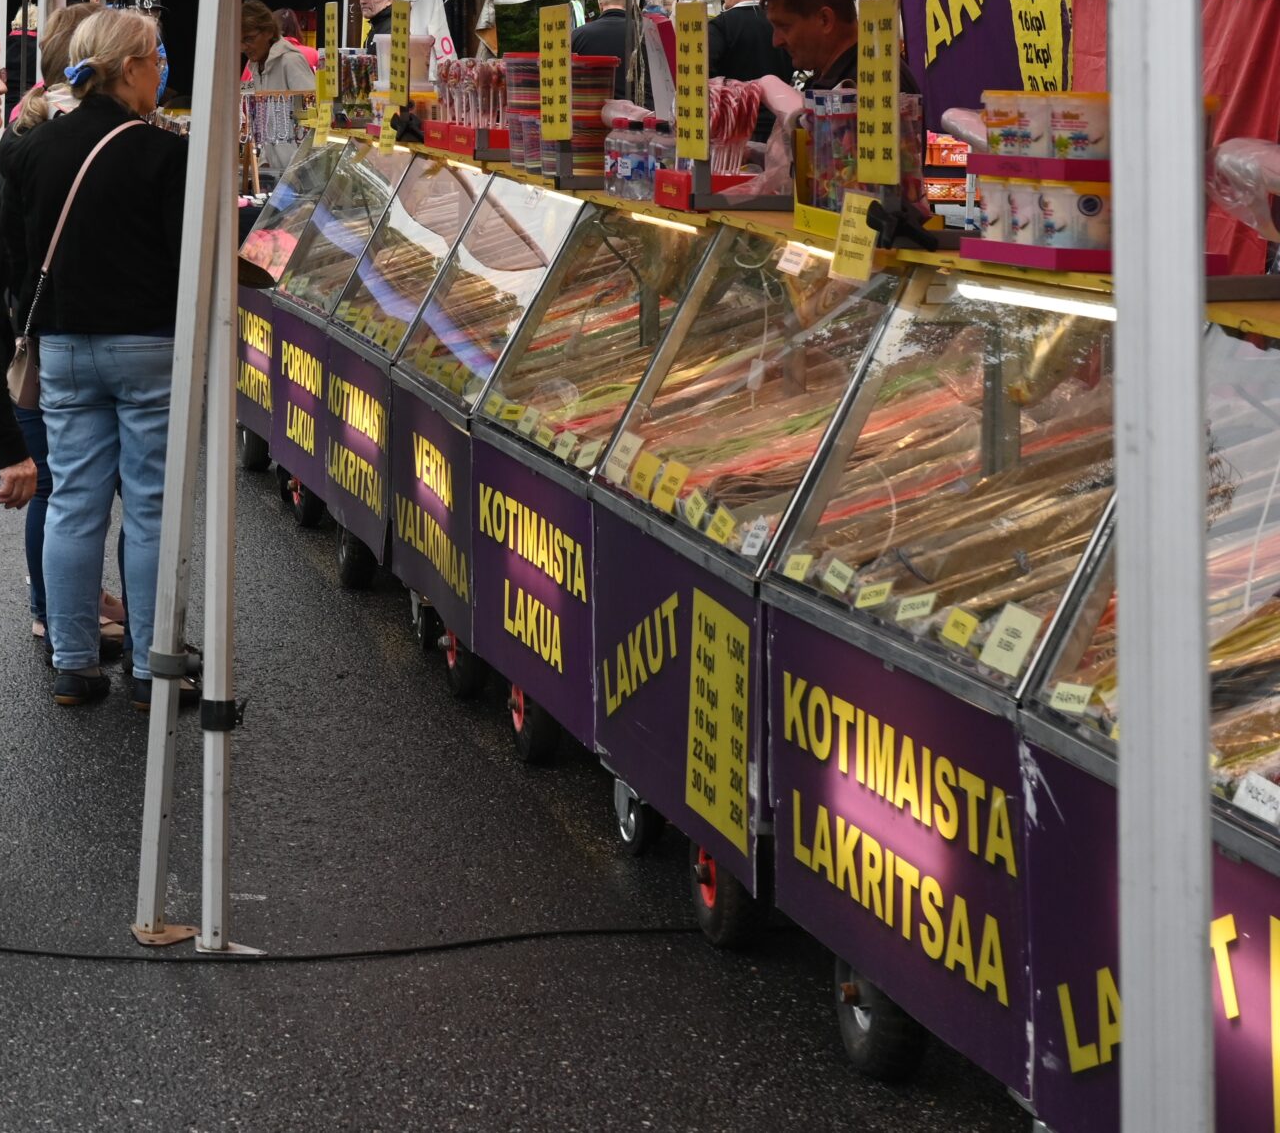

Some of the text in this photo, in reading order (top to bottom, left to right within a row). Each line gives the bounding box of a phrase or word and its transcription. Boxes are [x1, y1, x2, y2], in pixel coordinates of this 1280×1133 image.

[1018, 10, 1046, 37] 16 kpl
[1023, 43, 1053, 68] 22 kpl
[237, 306, 273, 358] TUORETT
[282, 340, 322, 399] PORVOON
[287, 401, 314, 456] LAKUA
[328, 371, 387, 454] KOTIMAISTA
[328, 436, 382, 519] LAKRITSAA
[413, 432, 453, 512] VERTAA
[396, 493, 469, 603] VALIKOIMAA
[479, 482, 587, 603] KOTIMAISTA
[504, 579, 562, 674] LAKUA
[603, 591, 679, 717] LAKUT
[698, 612, 745, 666] 1 kpl 1,50€
[696, 644, 745, 699] 4 kpl 5€
[696, 675, 744, 731] 10 kpl 10€
[694, 706, 744, 765] 16 kpl 15€
[693, 737, 744, 797] 22 kpl 20€
[783, 670, 1017, 877] KOTIMAISTA
[692, 769, 744, 830] 30 kpl 25€
[792, 789, 1009, 1008] LAKRITSAA
